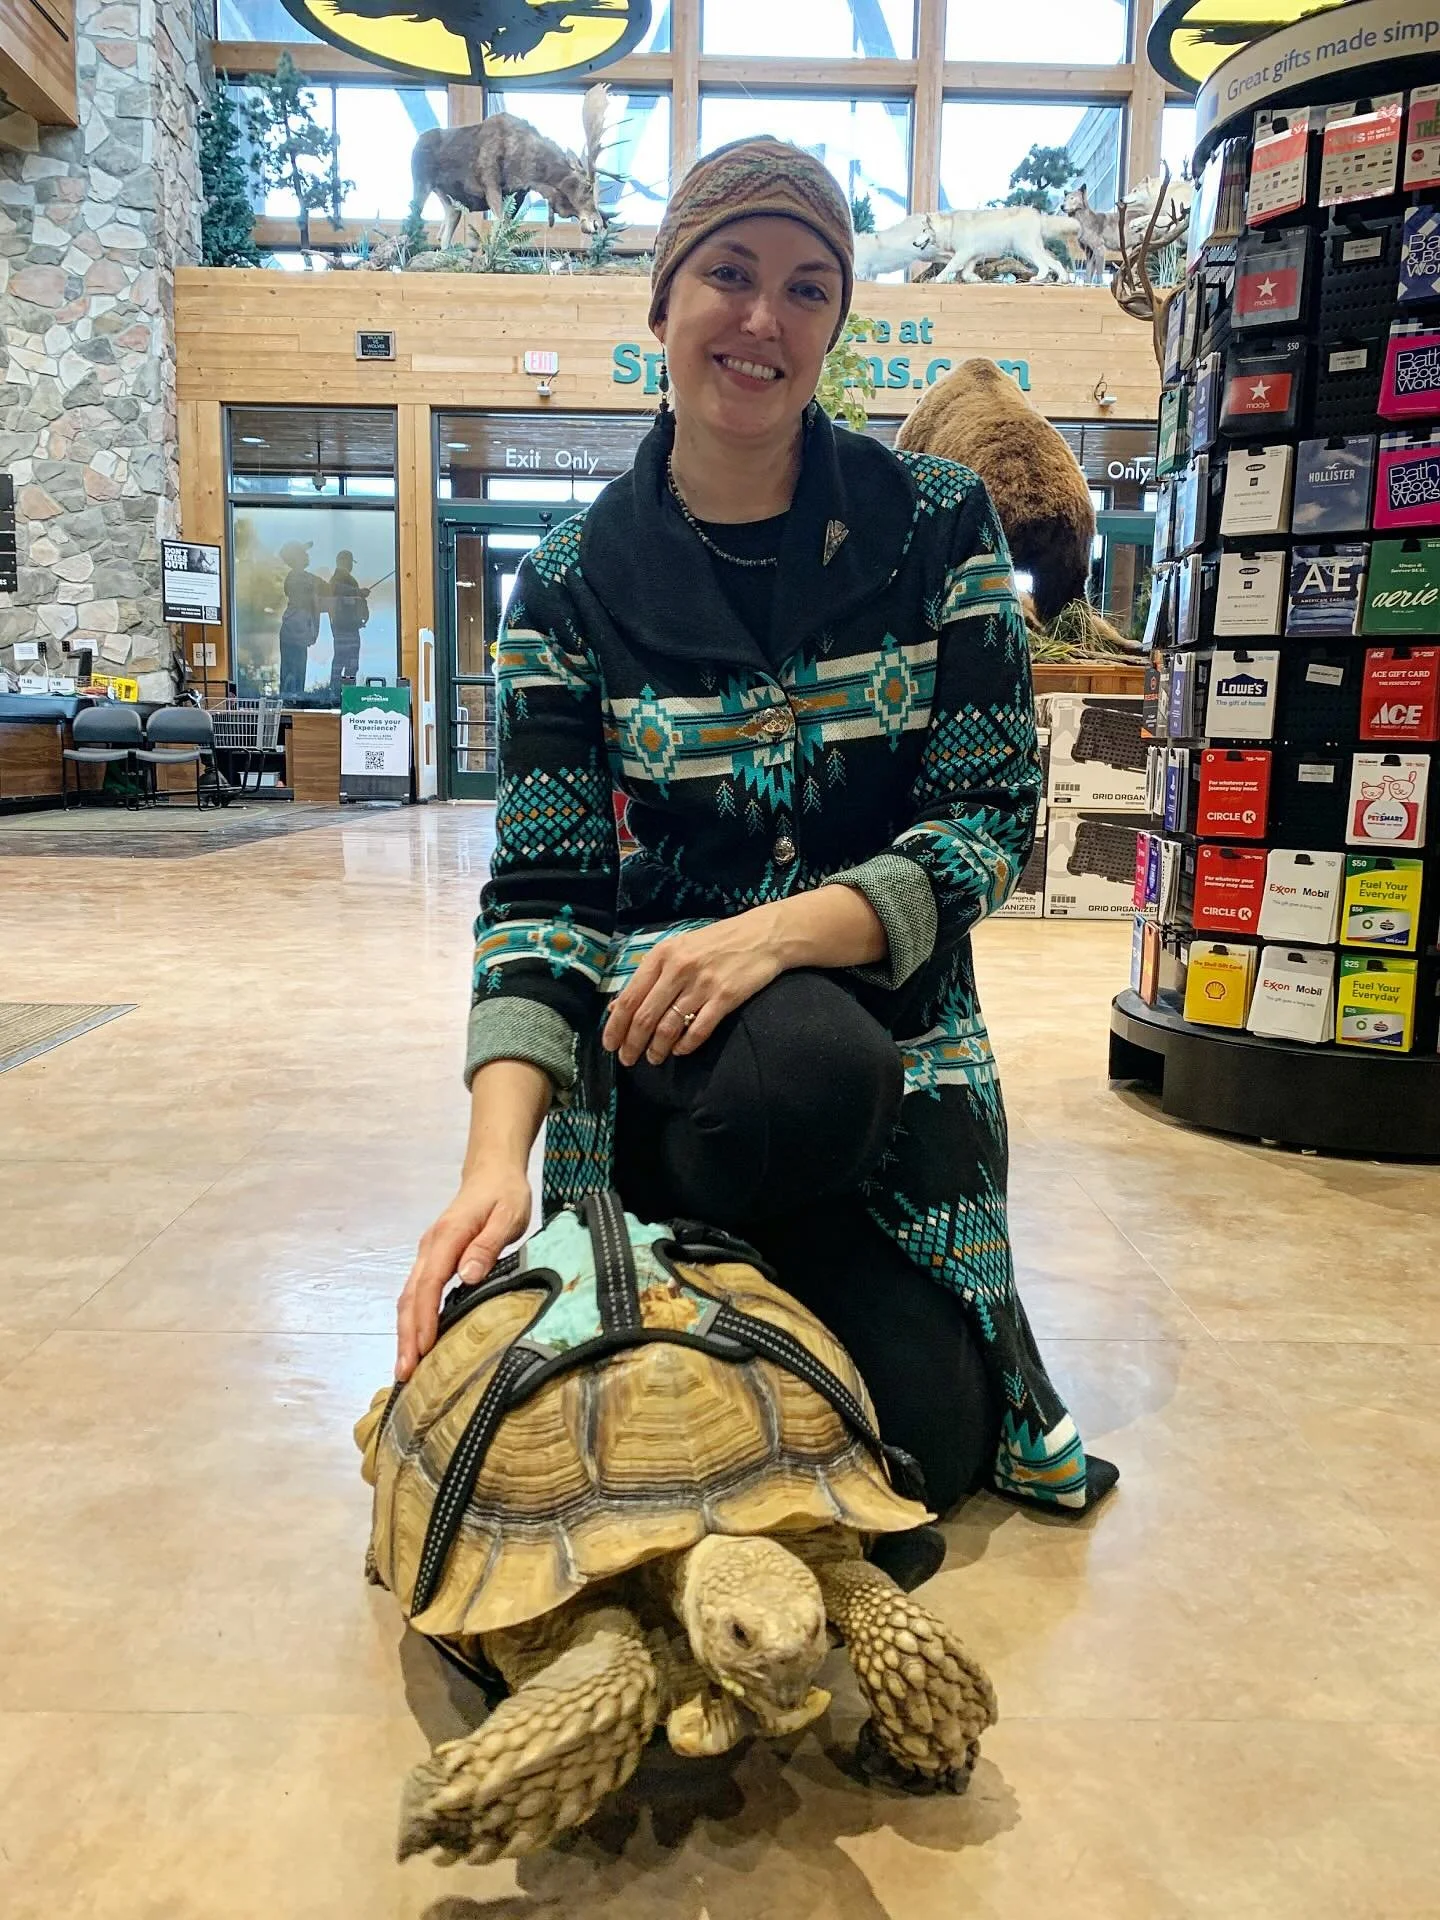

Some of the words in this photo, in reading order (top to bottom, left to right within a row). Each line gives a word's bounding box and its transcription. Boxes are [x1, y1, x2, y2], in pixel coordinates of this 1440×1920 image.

[1227, 67, 1269, 100] Great
[1272, 48, 1310, 82] gifts
[1316, 28, 1376, 60] made
[1383, 20, 1440, 43] simp
[899, 317, 933, 344] at
[530, 352, 553, 369] EXIT
[505, 449, 541, 468] Exit
[555, 450, 599, 474] Only
[1107, 461, 1151, 485] Only
[1309, 470, 1355, 482] HOLLISTER
[1390, 462, 1440, 485] Bath
[1391, 489, 1440, 506] Works
[165, 547, 188, 555] DON'T
[165, 561, 188, 570] OUT!
[1298, 562, 1351, 593] AE
[1372, 582, 1439, 608] aerie
[1408, 670, 1430, 678] CARD
[1221, 682, 1264, 695] LOWE'S
[1371, 701, 1423, 725] ACE
[1207, 812, 1240, 821] CIRCLE
[1270, 884, 1296, 895] Exxon
[1303, 888, 1329, 898] Mobil
[1360, 880, 1381, 889] Fuel
[1385, 882, 1408, 890] Your
[1359, 889, 1407, 902] Everyday
[1203, 907, 1236, 917] CIRCLE
[1344, 960, 1359, 968] $25
[1263, 980, 1290, 991] Exxon
[1296, 985, 1322, 996] Mobil
[1353, 980, 1374, 990] Fuel
[1377, 983, 1400, 992] Your
[1352, 990, 1399, 1003] Everyday
